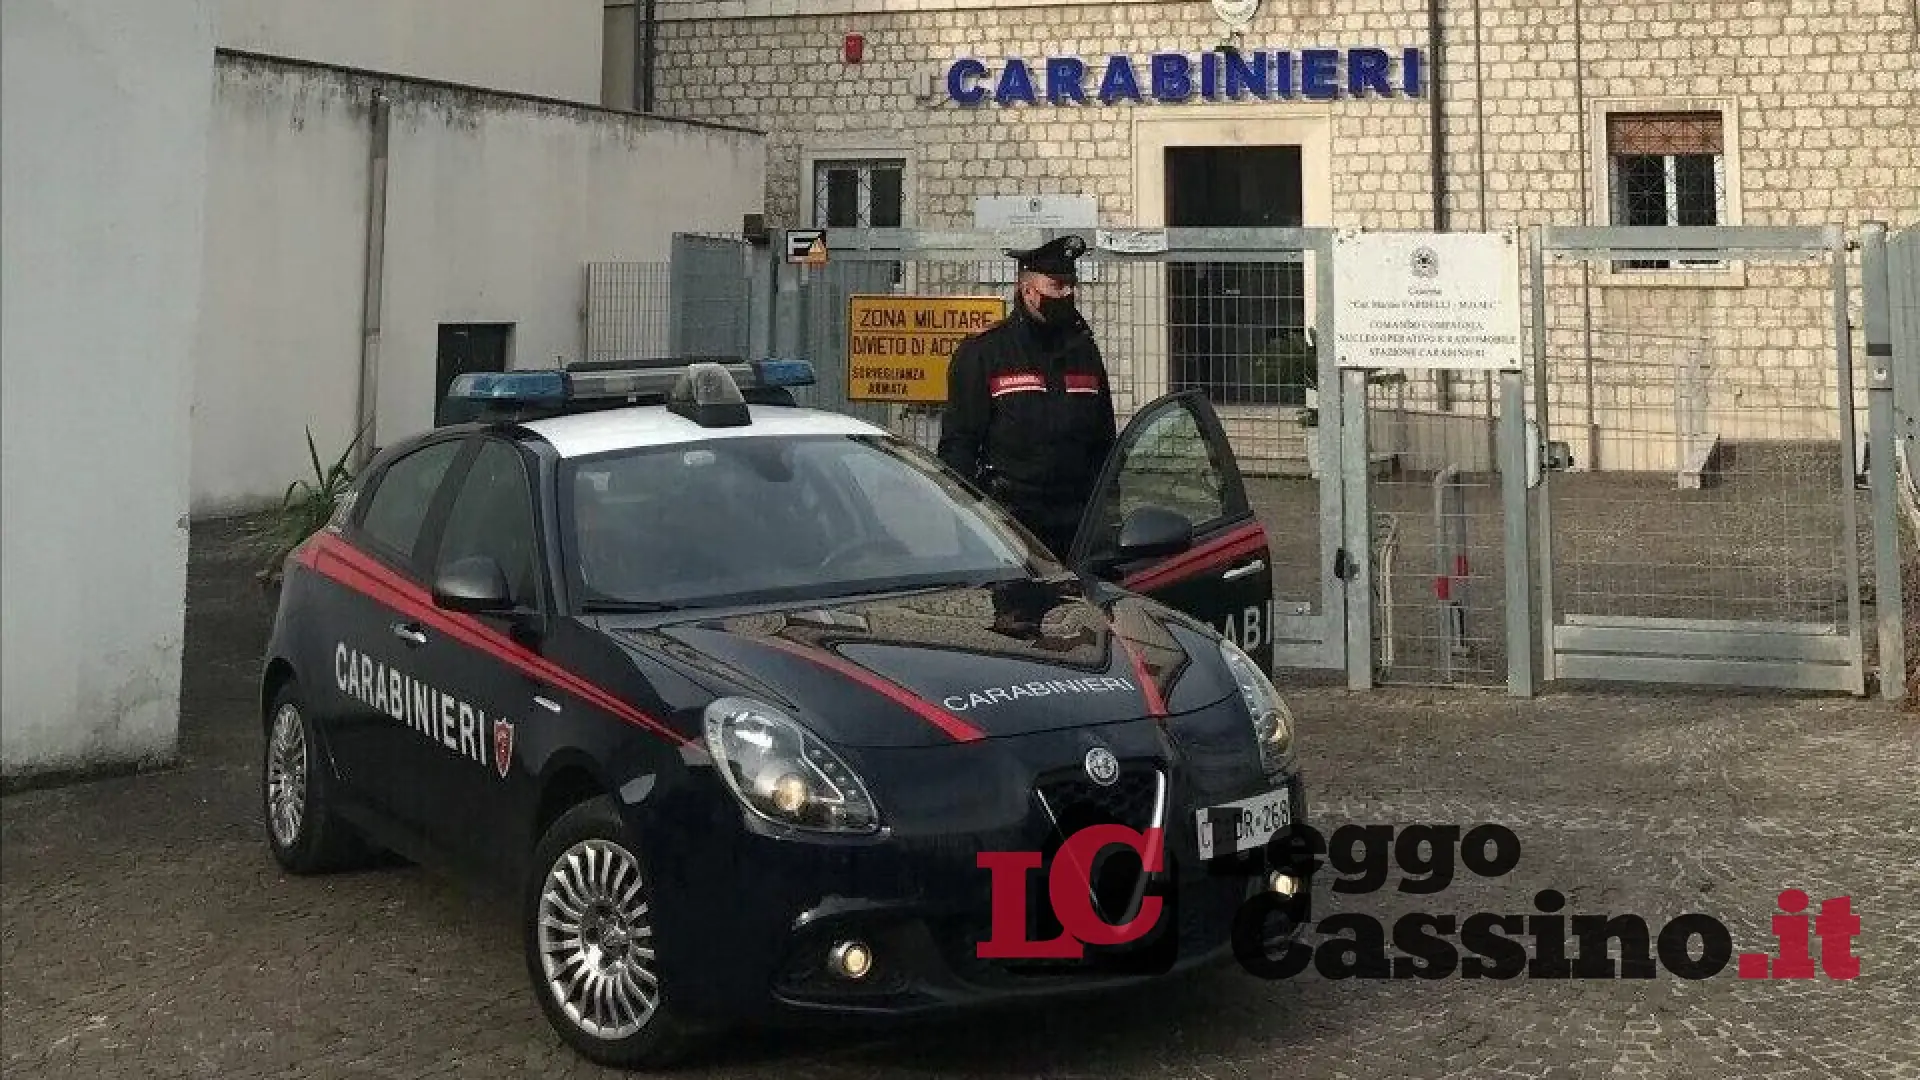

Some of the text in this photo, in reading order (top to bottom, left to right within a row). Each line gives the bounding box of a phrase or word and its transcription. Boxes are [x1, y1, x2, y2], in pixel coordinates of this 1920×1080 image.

[947, 47, 1419, 106] CARABINIERI
[859, 309, 994, 330] ZONA MILITARE
[852, 337, 907, 355] DIVIETO
[911, 337, 925, 356] DI
[852, 366, 926, 381] SORVEGLIANZA
[867, 382, 909, 396] ARMATA
[335, 641, 487, 767] CARABINIERI
[943, 677, 1136, 712] CARABINIERI
